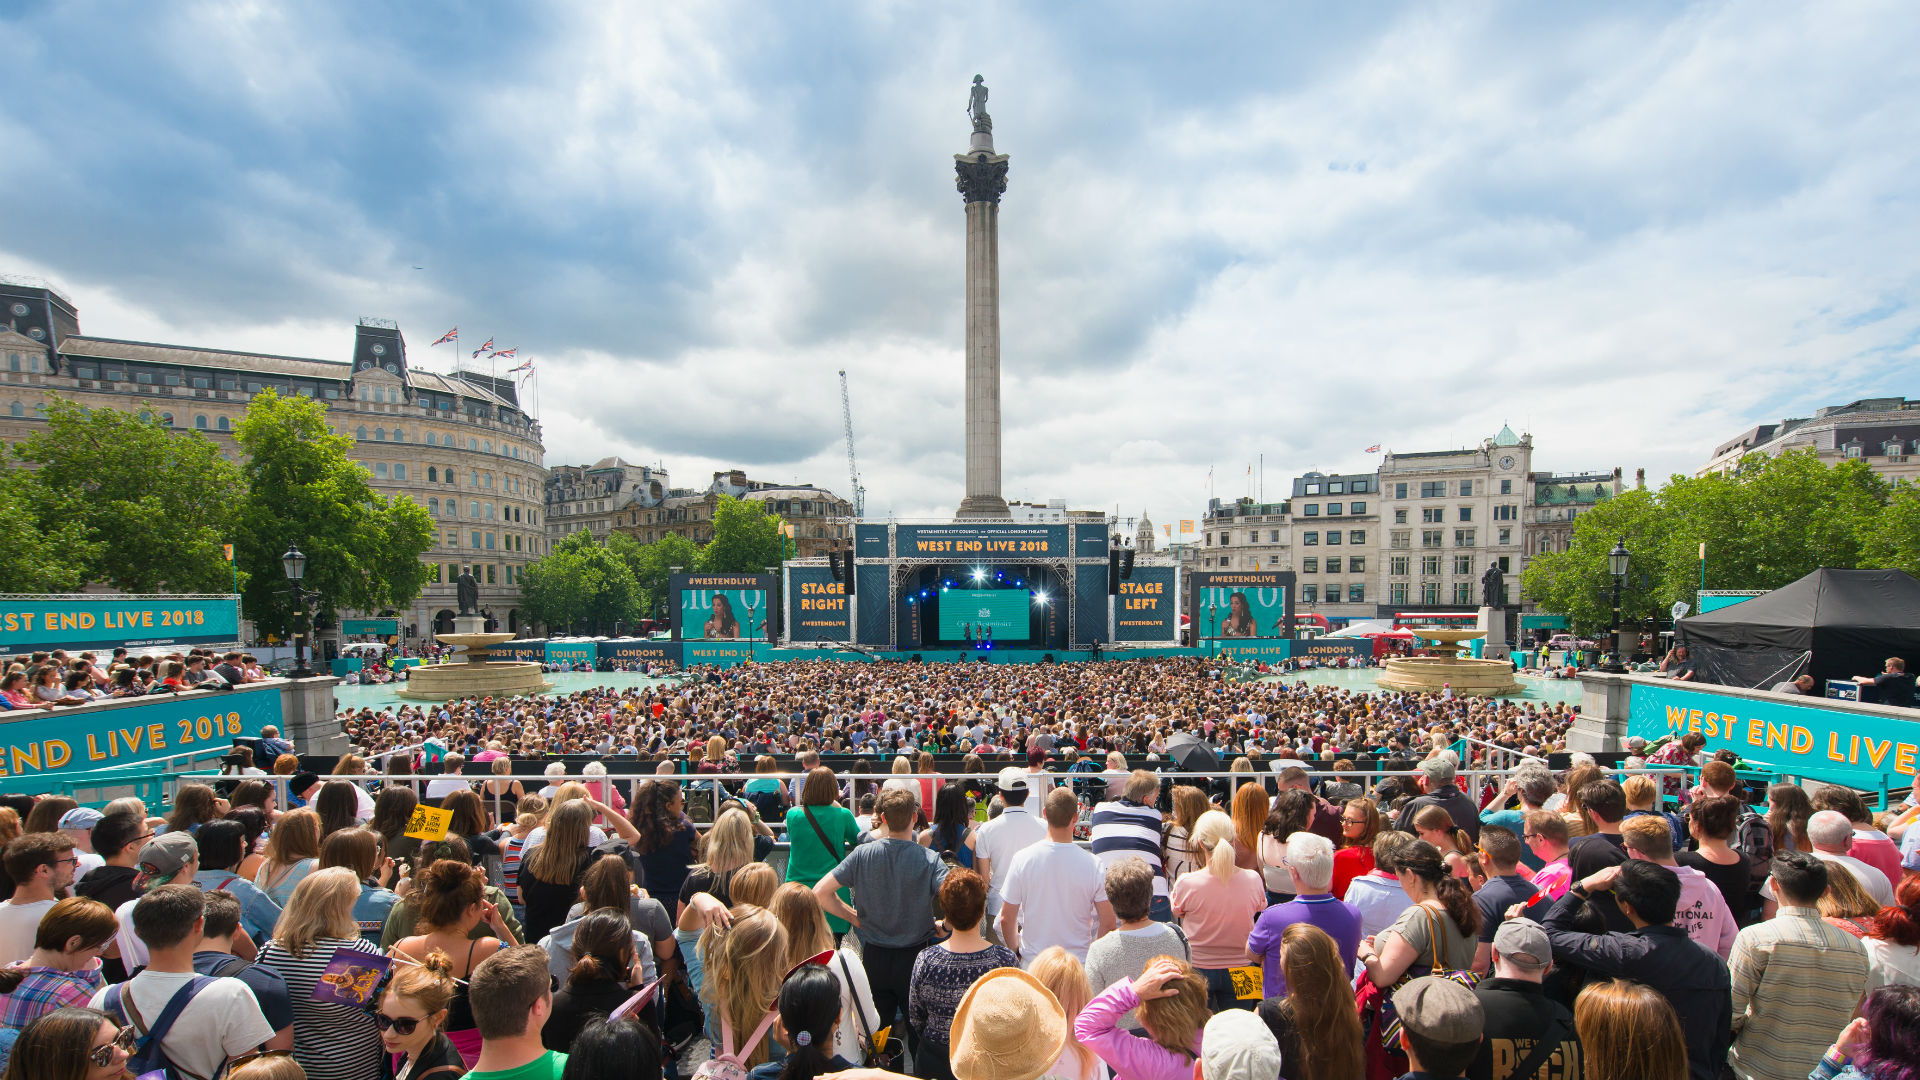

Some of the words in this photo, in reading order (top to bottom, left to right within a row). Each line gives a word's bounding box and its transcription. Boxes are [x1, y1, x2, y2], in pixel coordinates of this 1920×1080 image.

[917, 541, 952, 551] WEST
[956, 541, 983, 551] END
[987, 541, 1016, 551] LIVE
[1020, 541, 1049, 551] 2018
[689, 577, 757, 585] #WESTENDLIVE
[1209, 575, 1277, 583] #WESTENDLIVE
[801, 583, 845, 594] STAGE
[1120, 583, 1163, 594] STAGE
[801, 599, 845, 610] RIGHT
[1126, 598, 1158, 610] LEFT
[45, 612, 97, 630] END
[104, 611, 154, 628] LIVE
[161, 610, 205, 626] 2018
[617, 649, 664, 657] LONDON'S
[693, 649, 717, 657] WEST
[720, 649, 738, 657] END
[741, 649, 758, 657] LIV
[1308, 646, 1354, 654] LONDON'S
[87, 723, 166, 762] LIVE
[178, 711, 242, 744] 2018
[1666, 705, 1737, 740] WEST
[1747, 719, 1814, 754] END
[1828, 731, 1919, 776] LIVE
[1515, 1038, 1531, 1048] WE
